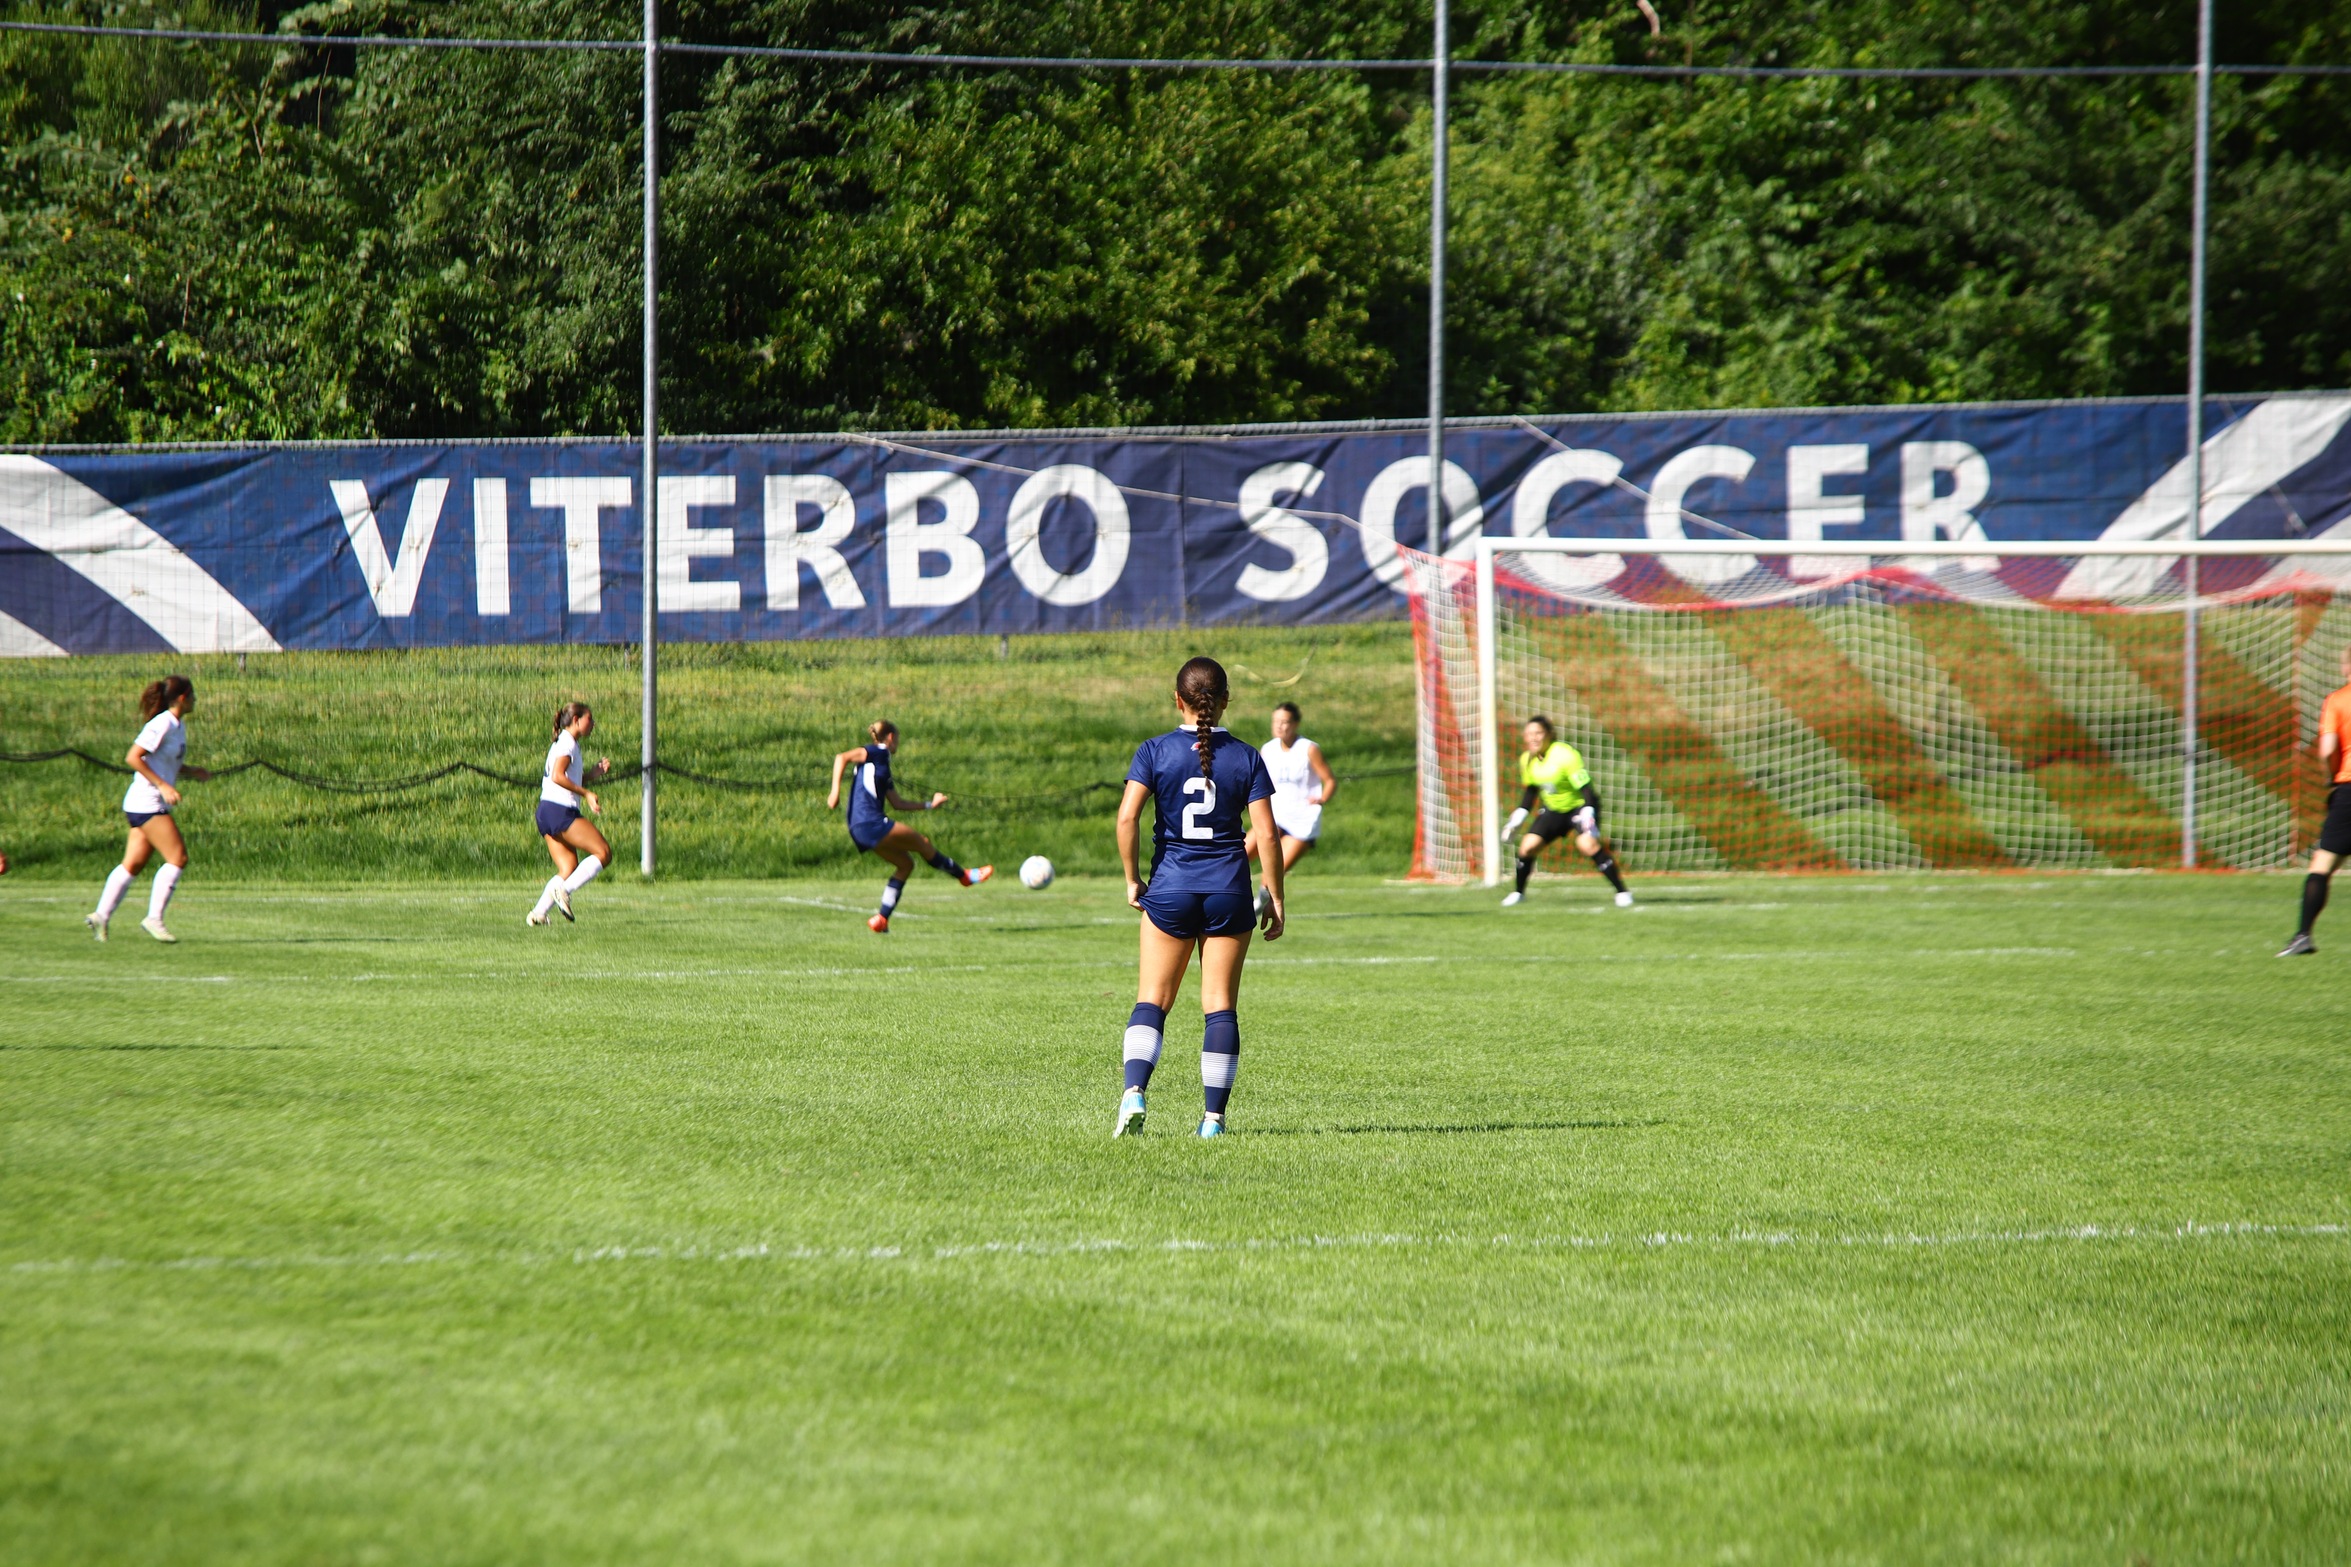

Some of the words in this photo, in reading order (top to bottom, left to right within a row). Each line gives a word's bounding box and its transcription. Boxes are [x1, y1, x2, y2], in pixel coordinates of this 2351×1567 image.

[328, 463, 1131, 616] VITERBO
[1236, 440, 2000, 601] SOCCER
[1182, 777, 1216, 840] 2
